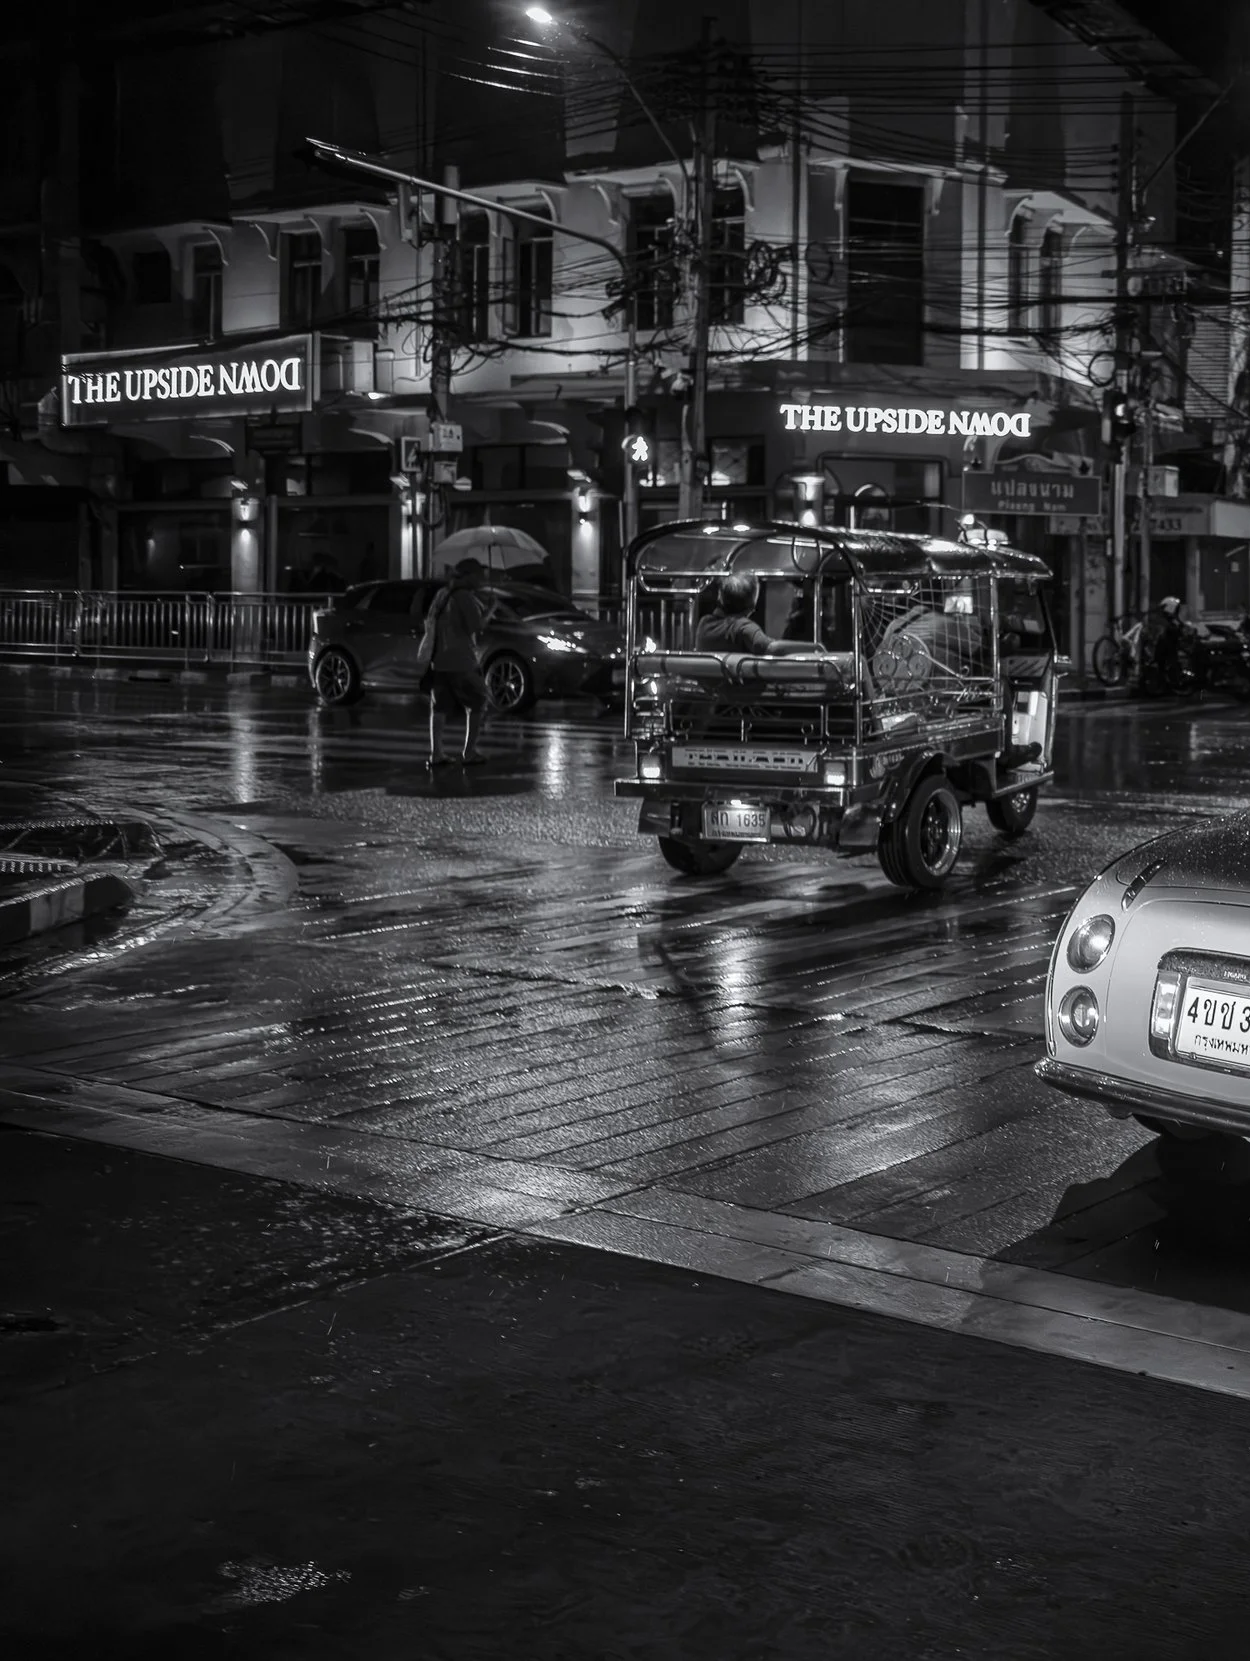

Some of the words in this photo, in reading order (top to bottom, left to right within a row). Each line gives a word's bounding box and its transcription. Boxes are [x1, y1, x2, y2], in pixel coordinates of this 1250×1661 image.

[68, 371, 121, 404] THE
[124, 364, 214, 401] UPSIDE
[780, 404, 842, 431] THE
[845, 406, 945, 435] UPSIDE
[737, 813, 766, 827] 1635
